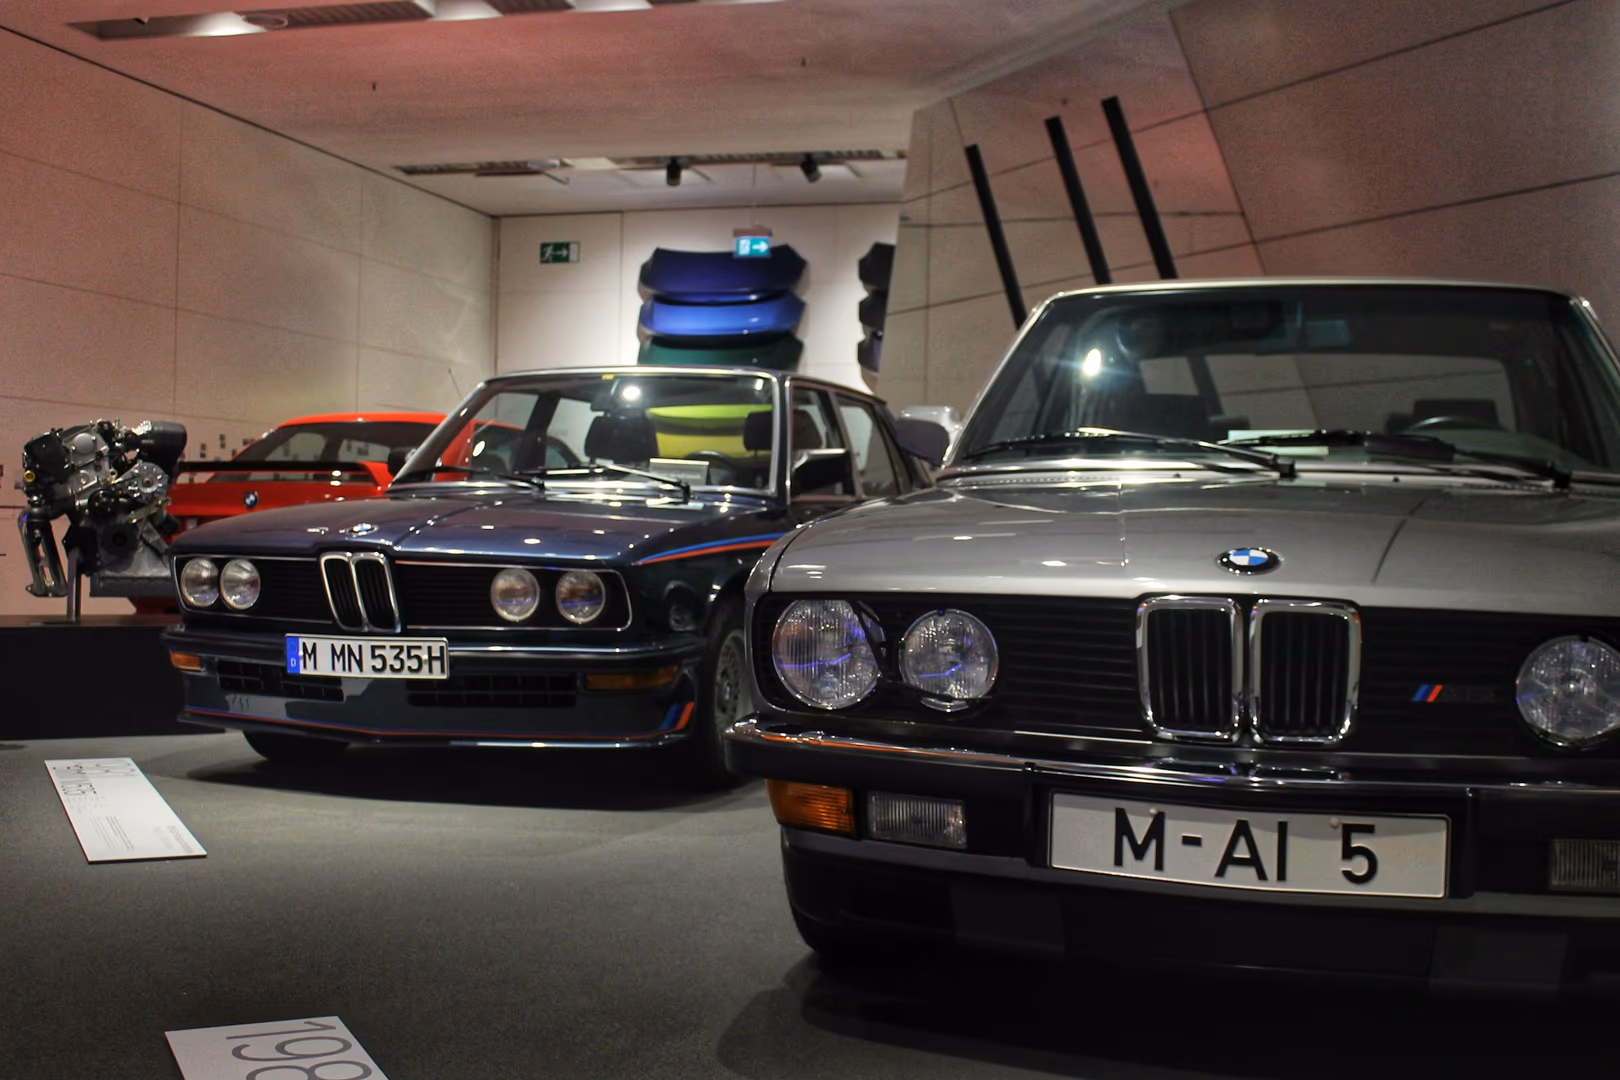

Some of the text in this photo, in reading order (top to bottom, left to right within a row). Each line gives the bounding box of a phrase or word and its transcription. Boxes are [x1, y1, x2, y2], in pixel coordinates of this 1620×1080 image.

[290, 658, 297, 667] D
[302, 641, 446, 674] M MN 535H
[1340, 823, 1379, 884] 5
